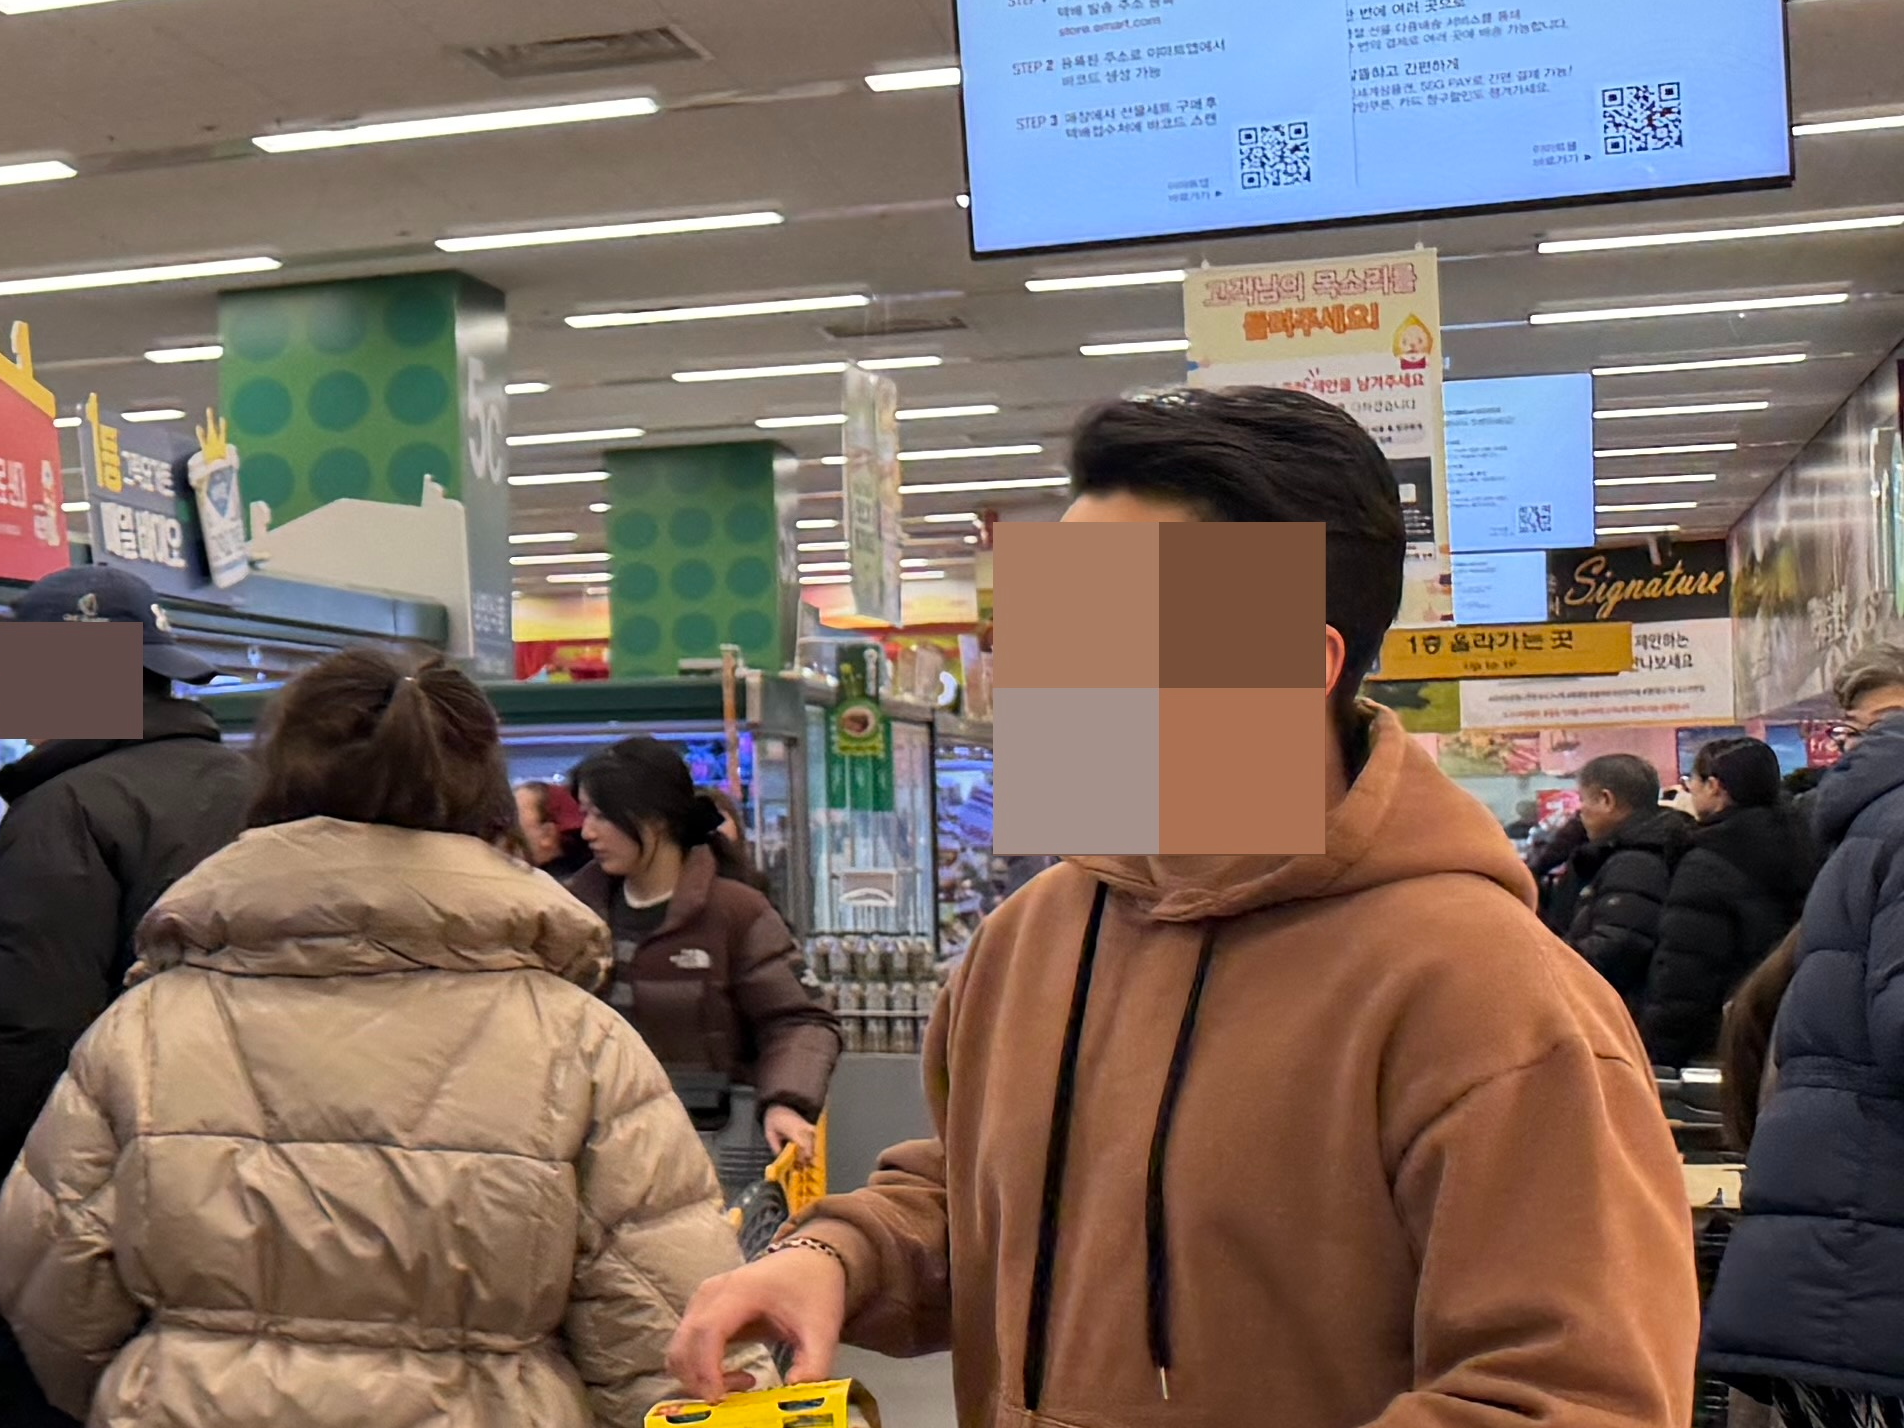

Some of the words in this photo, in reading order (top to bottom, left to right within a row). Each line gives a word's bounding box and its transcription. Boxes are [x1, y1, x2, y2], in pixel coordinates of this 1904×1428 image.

[1012, 61, 1043, 76] STEP
[1016, 116, 1047, 131] STEP
[1203, 272, 1306, 307] 고객님의
[1312, 262, 1418, 299] 목소리를
[1564, 555, 1726, 620] Signature
[1450, 629, 1544, 654] 올라가는
[1550, 628, 1574, 651] 곳
